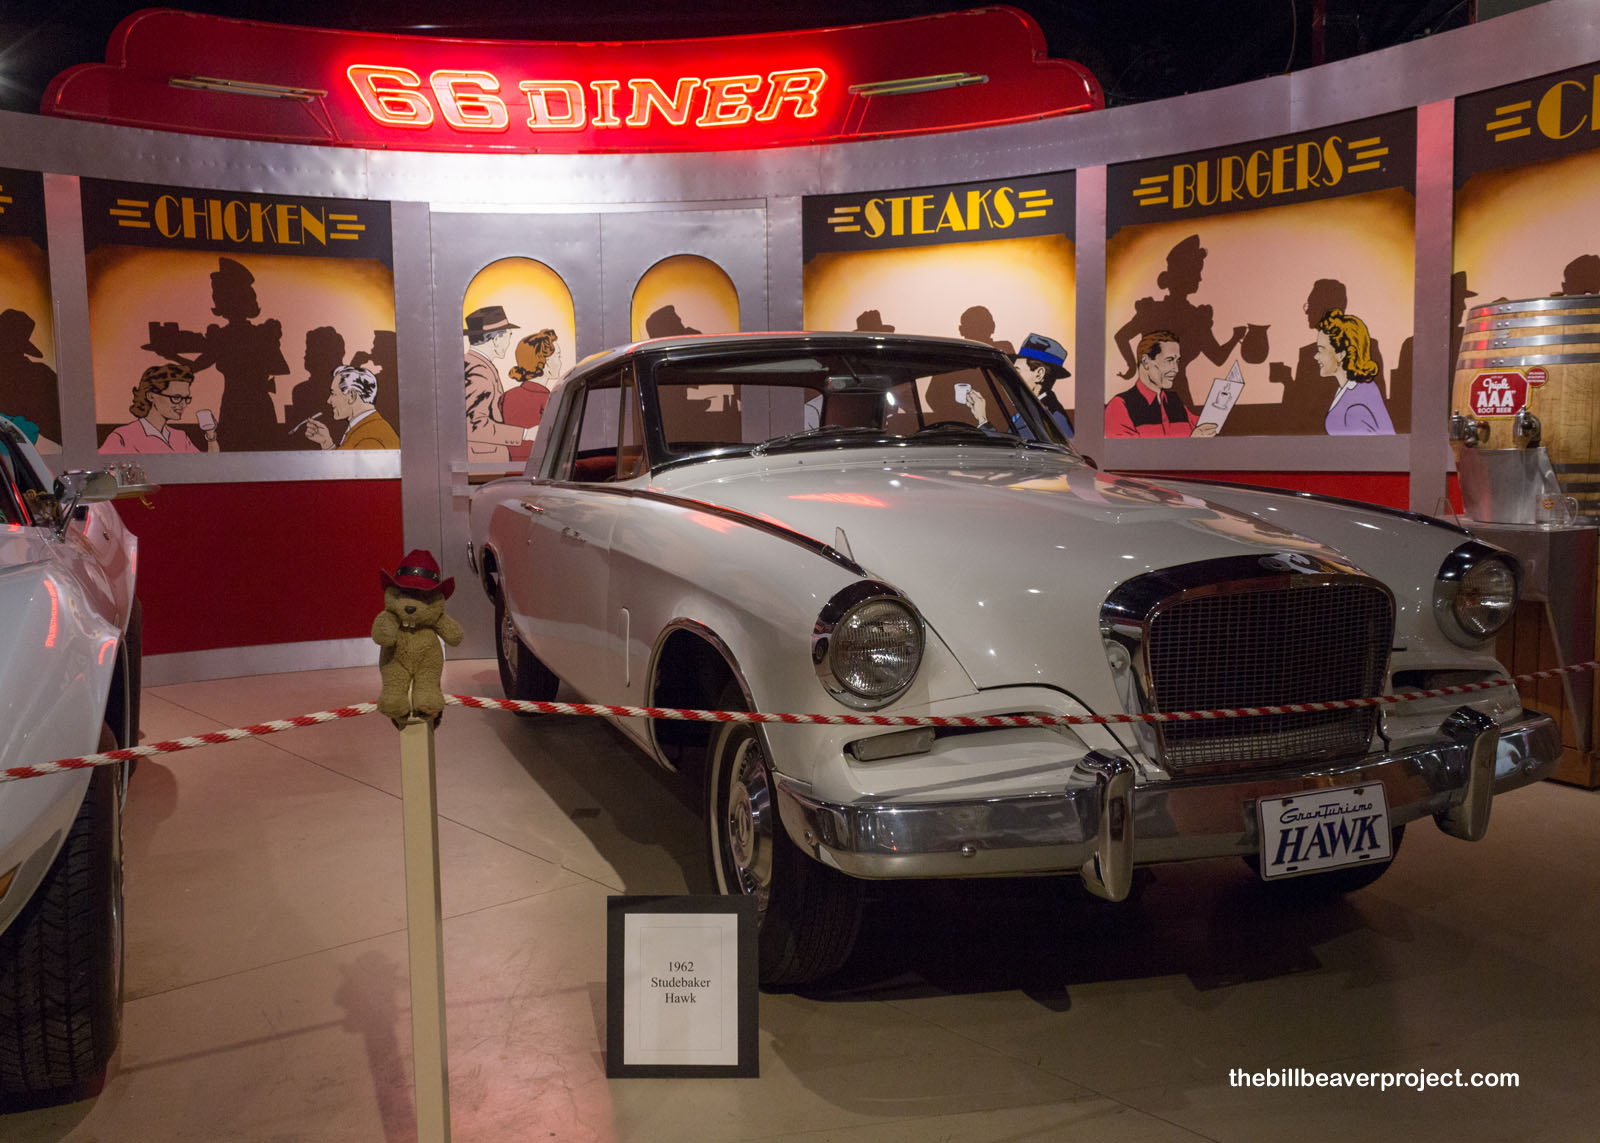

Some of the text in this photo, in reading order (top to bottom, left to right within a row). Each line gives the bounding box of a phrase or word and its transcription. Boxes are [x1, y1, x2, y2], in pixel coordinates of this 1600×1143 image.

[346, 63, 826, 132] 66 DINER
[1173, 136, 1344, 209] BURGERS
[154, 194, 327, 246] CHICKEN
[864, 186, 1016, 239] STEAKS
[1482, 377, 1511, 395] Triple
[1271, 814, 1383, 866] HAWK
[651, 977, 711, 988] Studebaker
[669, 961, 694, 972] 1962
[665, 992, 696, 1003] Hawk
